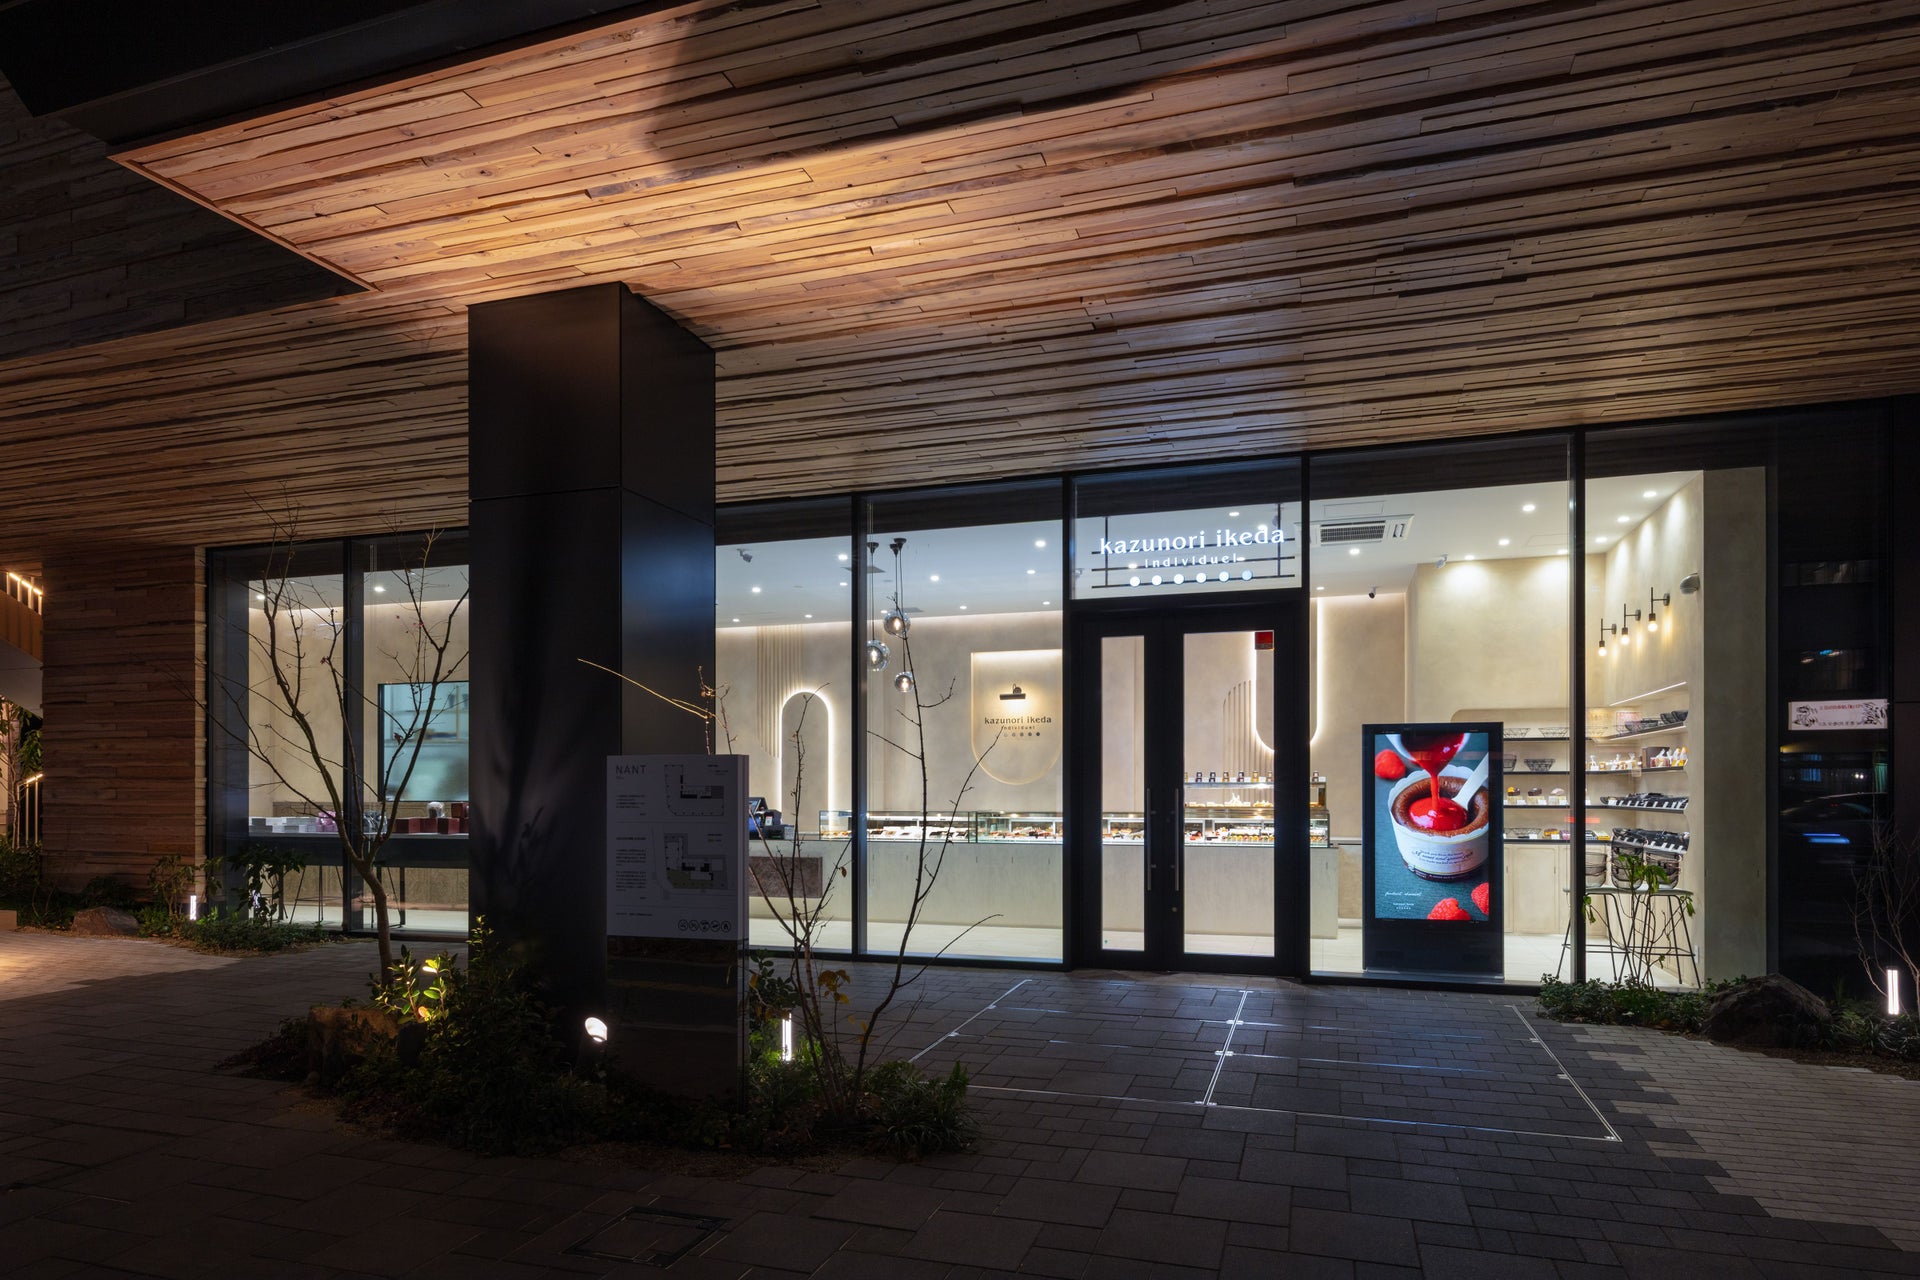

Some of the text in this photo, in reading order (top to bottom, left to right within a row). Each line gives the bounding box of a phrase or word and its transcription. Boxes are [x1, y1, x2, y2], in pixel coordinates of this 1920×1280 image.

[1100, 526, 1285, 555] kazunori ikeda
[984, 715, 1052, 725] kazunori ikeda
[616, 764, 647, 775] NANT
